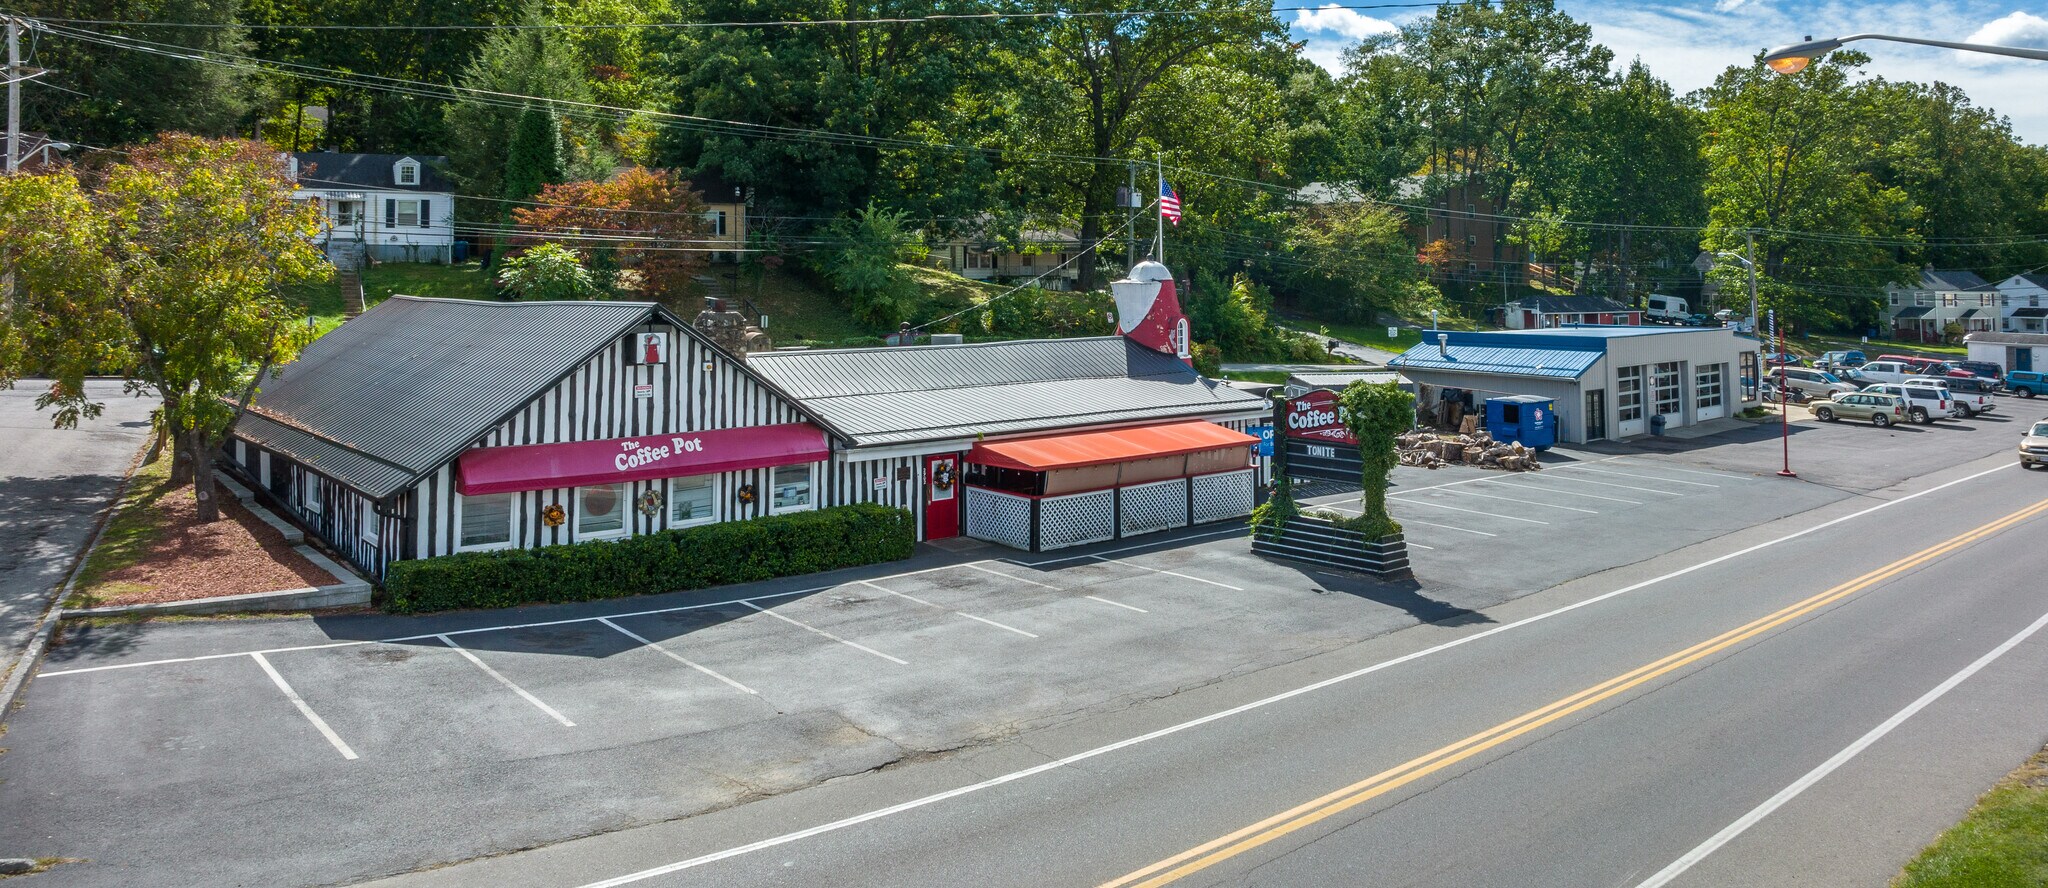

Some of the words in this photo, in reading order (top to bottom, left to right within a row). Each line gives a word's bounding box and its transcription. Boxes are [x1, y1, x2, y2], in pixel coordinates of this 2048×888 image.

[1296, 401, 1311, 411] The
[1288, 410, 1335, 429] Coffee
[621, 441, 640, 451] The
[1307, 445, 1335, 458] TONITE
[615, 446, 669, 471] Coffee
[671, 438, 703, 454] Pot
